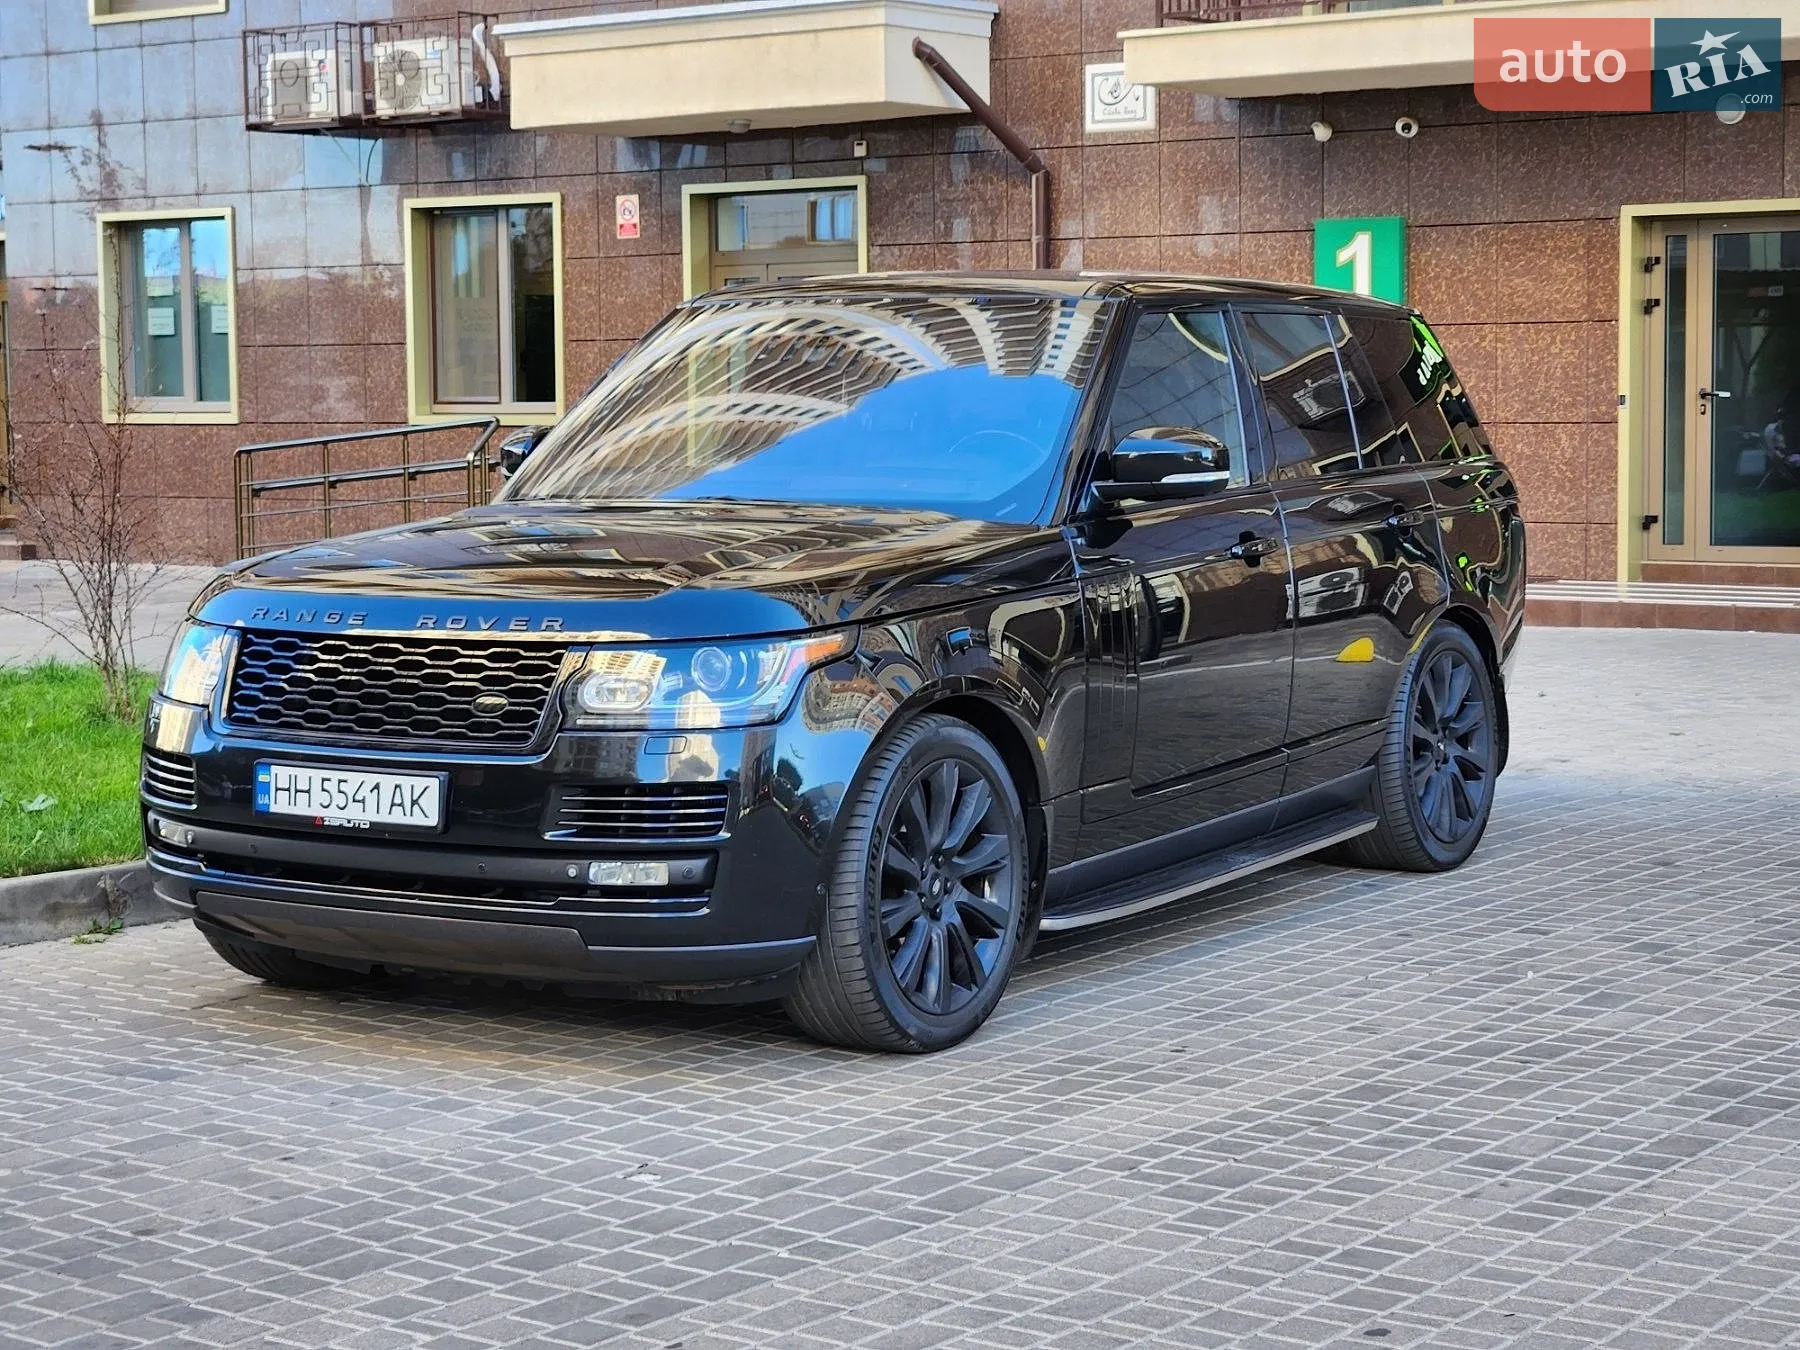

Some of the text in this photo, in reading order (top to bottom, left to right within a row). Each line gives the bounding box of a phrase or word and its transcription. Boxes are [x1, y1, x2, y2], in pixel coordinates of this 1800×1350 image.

[1336, 231, 1373, 296] 1
[250, 606, 565, 632] RANGE ROVER
[257, 793, 270, 805] UA
